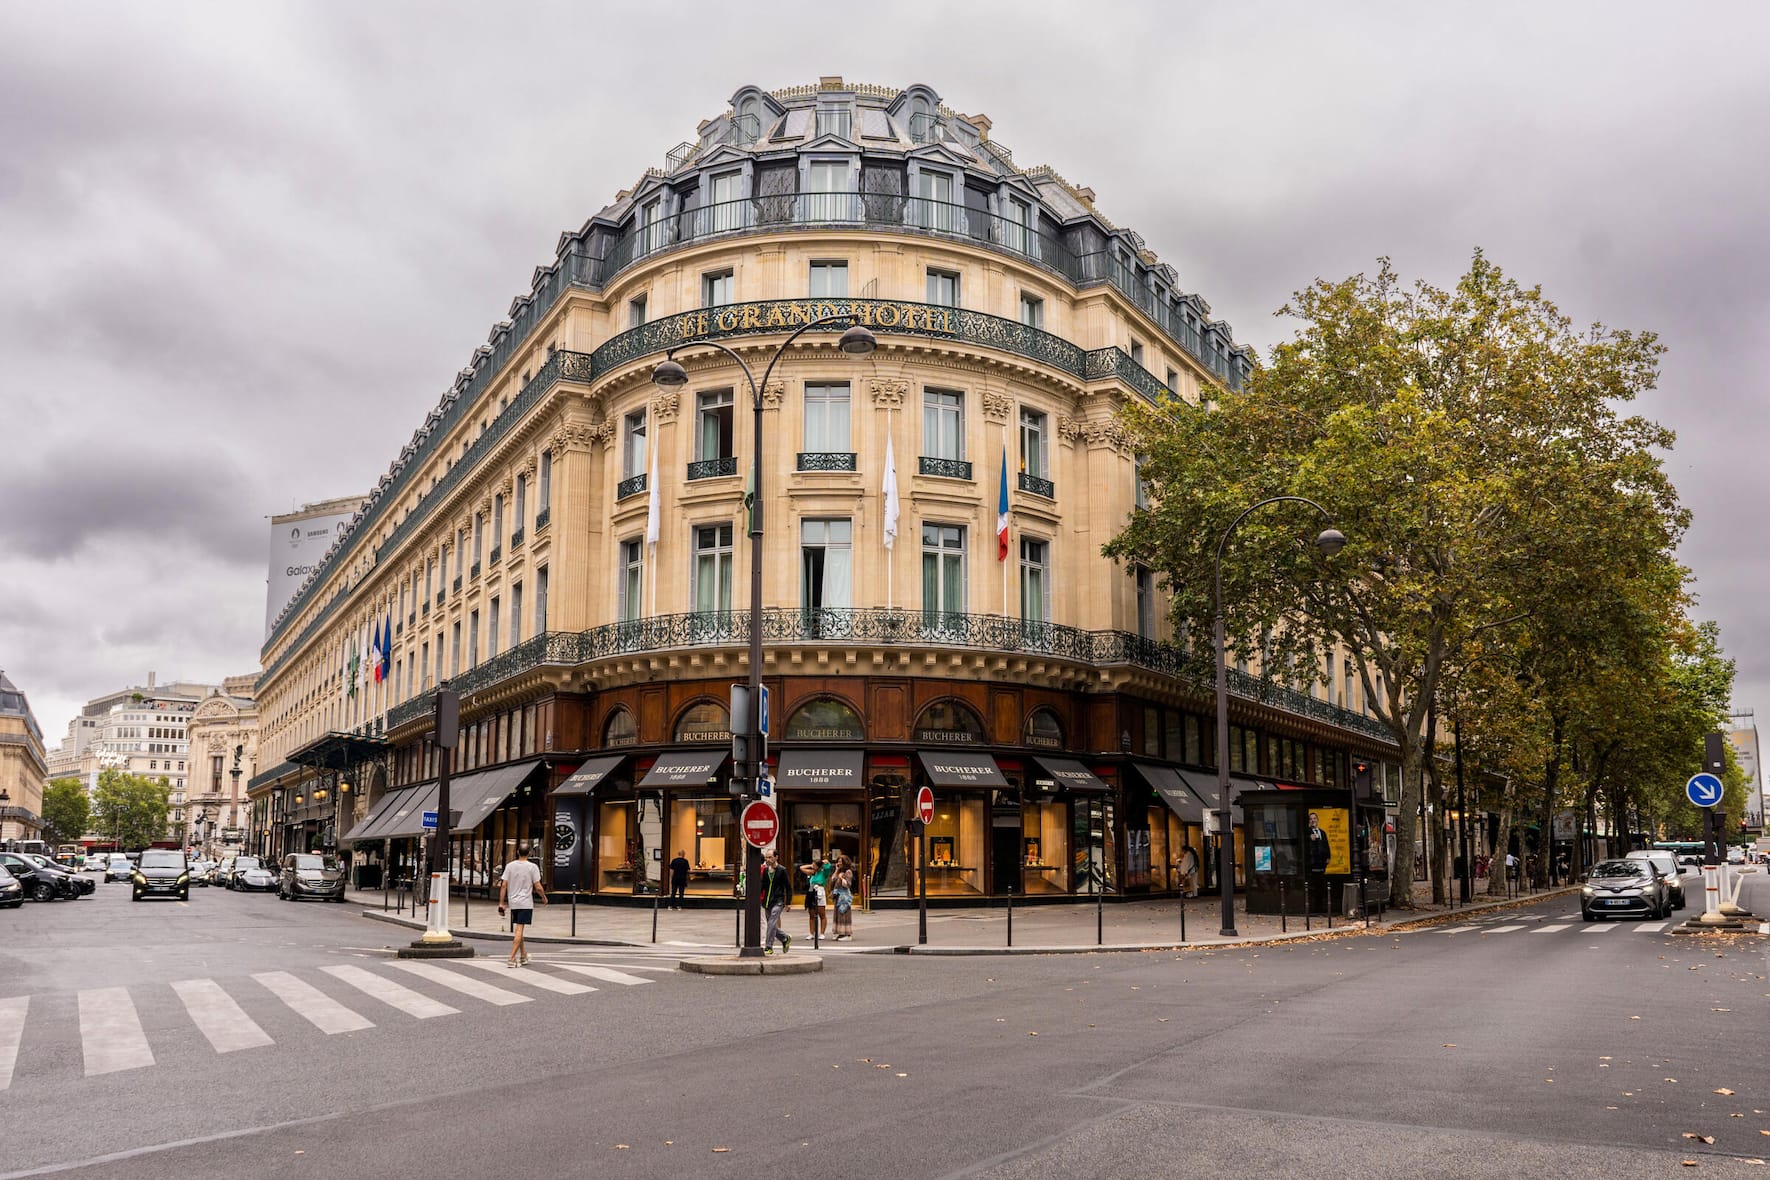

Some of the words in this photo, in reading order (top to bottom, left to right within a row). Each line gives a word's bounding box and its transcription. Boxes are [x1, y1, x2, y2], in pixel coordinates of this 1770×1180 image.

[681, 313, 709, 338] LE
[718, 302, 837, 331] GRAND
[848, 302, 957, 334] HOTEL
[286, 565, 316, 576] Galax
[682, 732, 731, 741] BUCHERER
[797, 729, 852, 738] BUCHERER
[922, 731, 972, 742] BUCHERER
[1026, 736, 1058, 746] BUCHERER
[655, 765, 711, 774] BUCHERER
[787, 768, 853, 777] BUCHERER
[934, 765, 994, 775] BUCHERER
